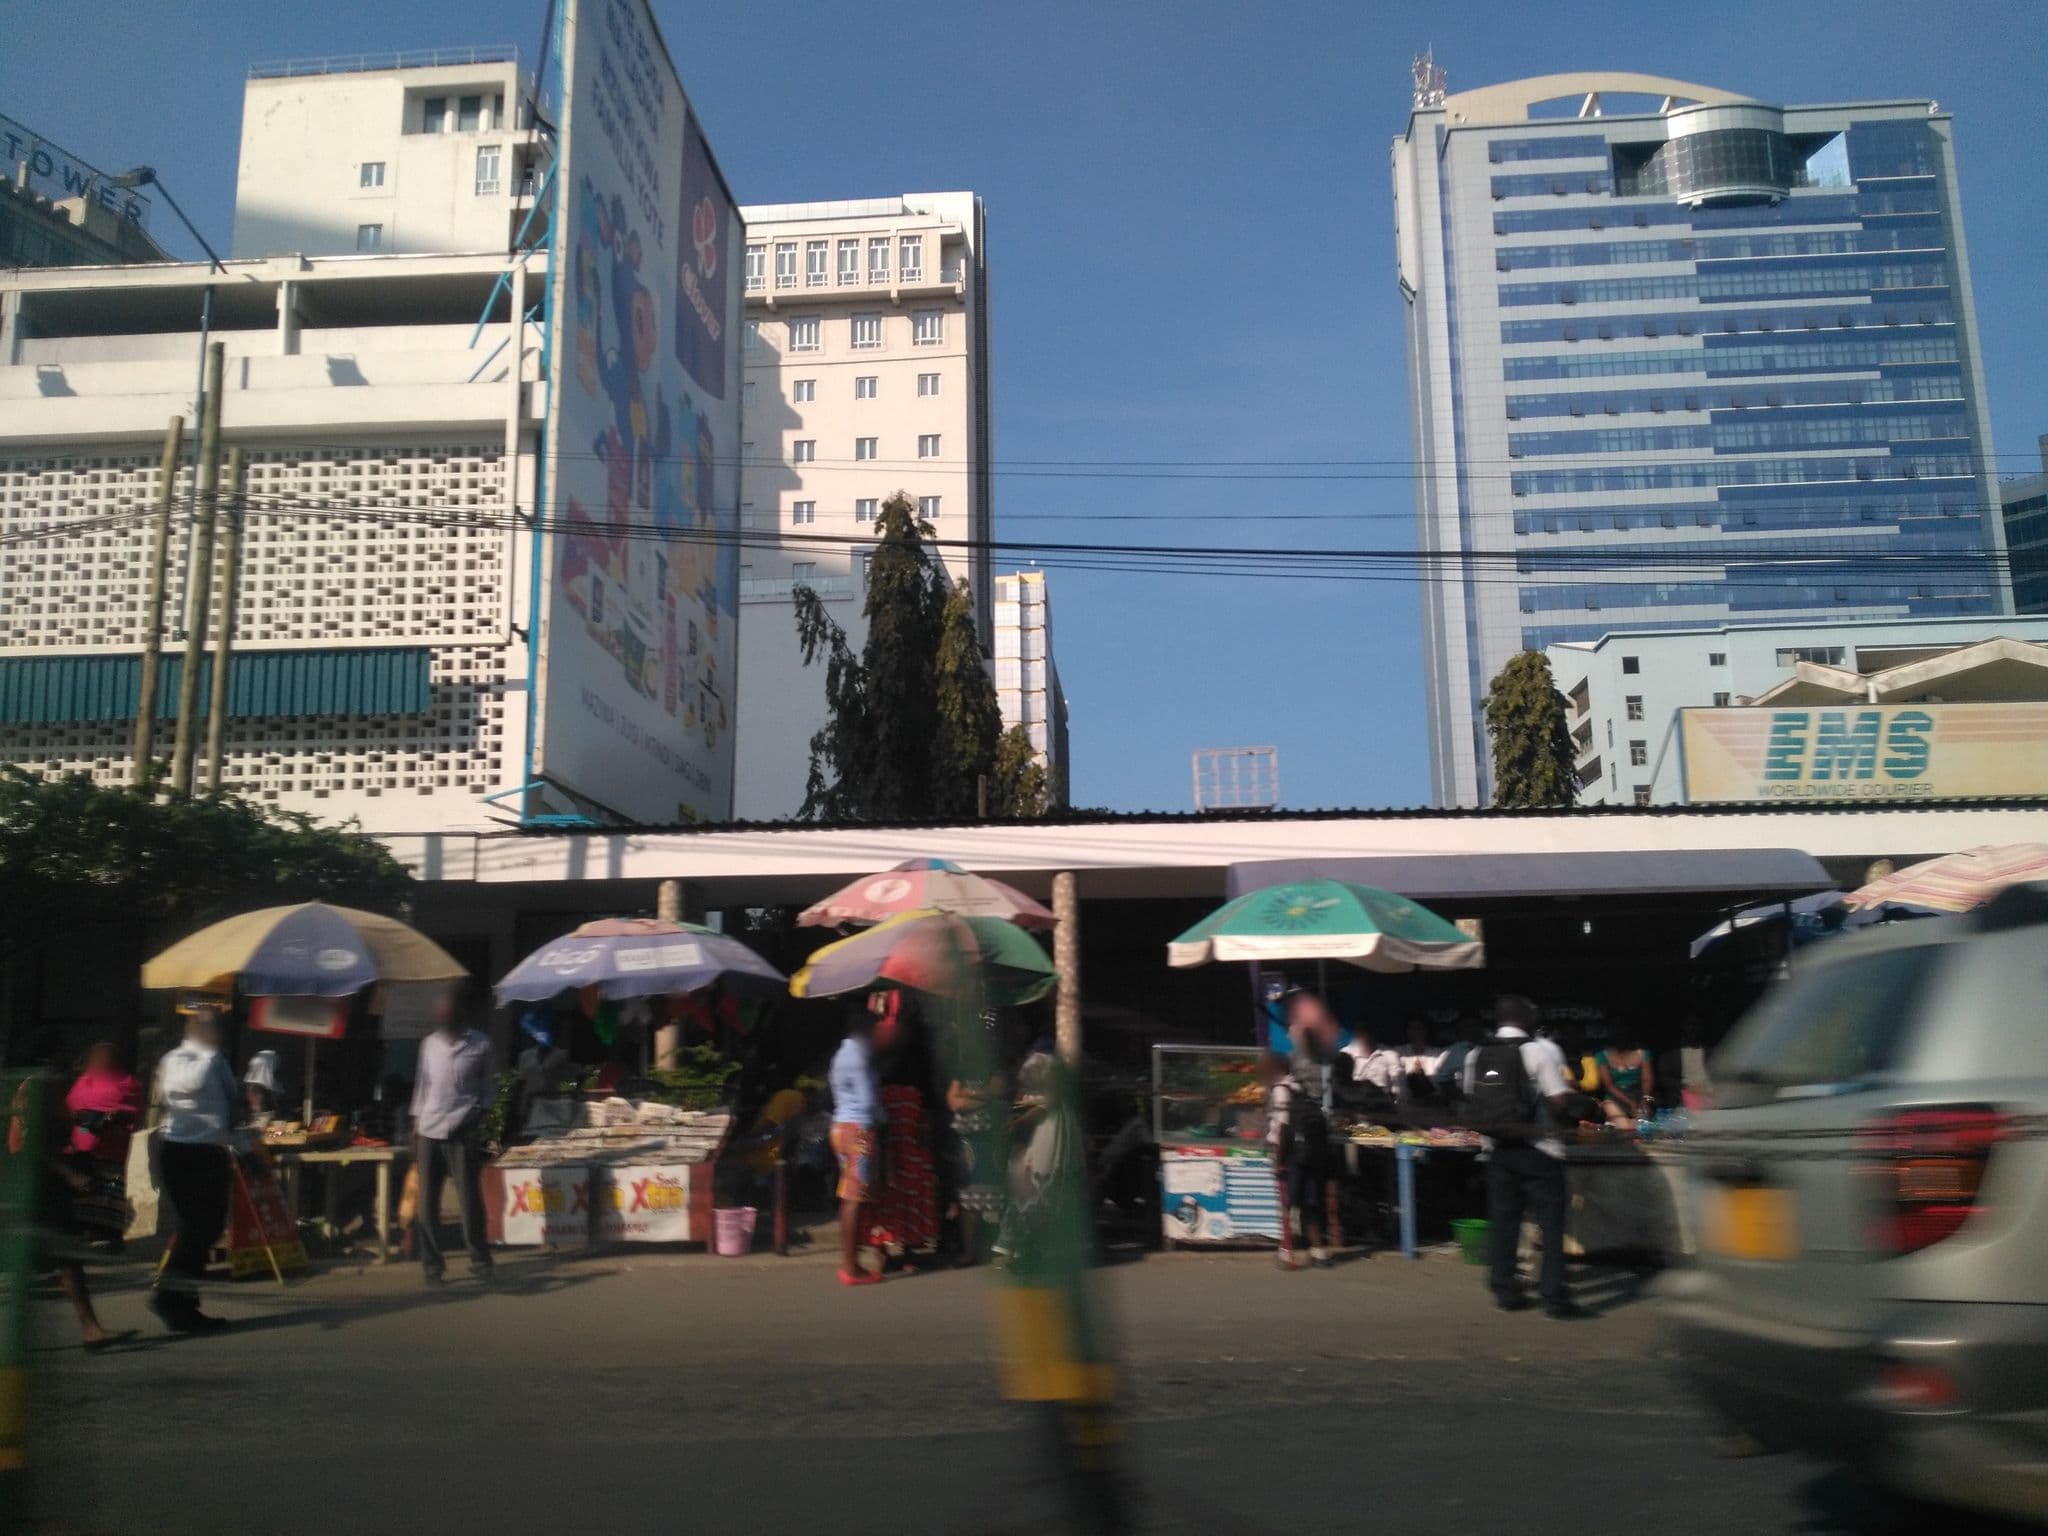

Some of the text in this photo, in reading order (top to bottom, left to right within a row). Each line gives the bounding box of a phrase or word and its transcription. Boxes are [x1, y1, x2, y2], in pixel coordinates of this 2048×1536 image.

[1764, 711, 1934, 780] EMS
[1759, 782, 1935, 797] WORLDWIDE COURIER
